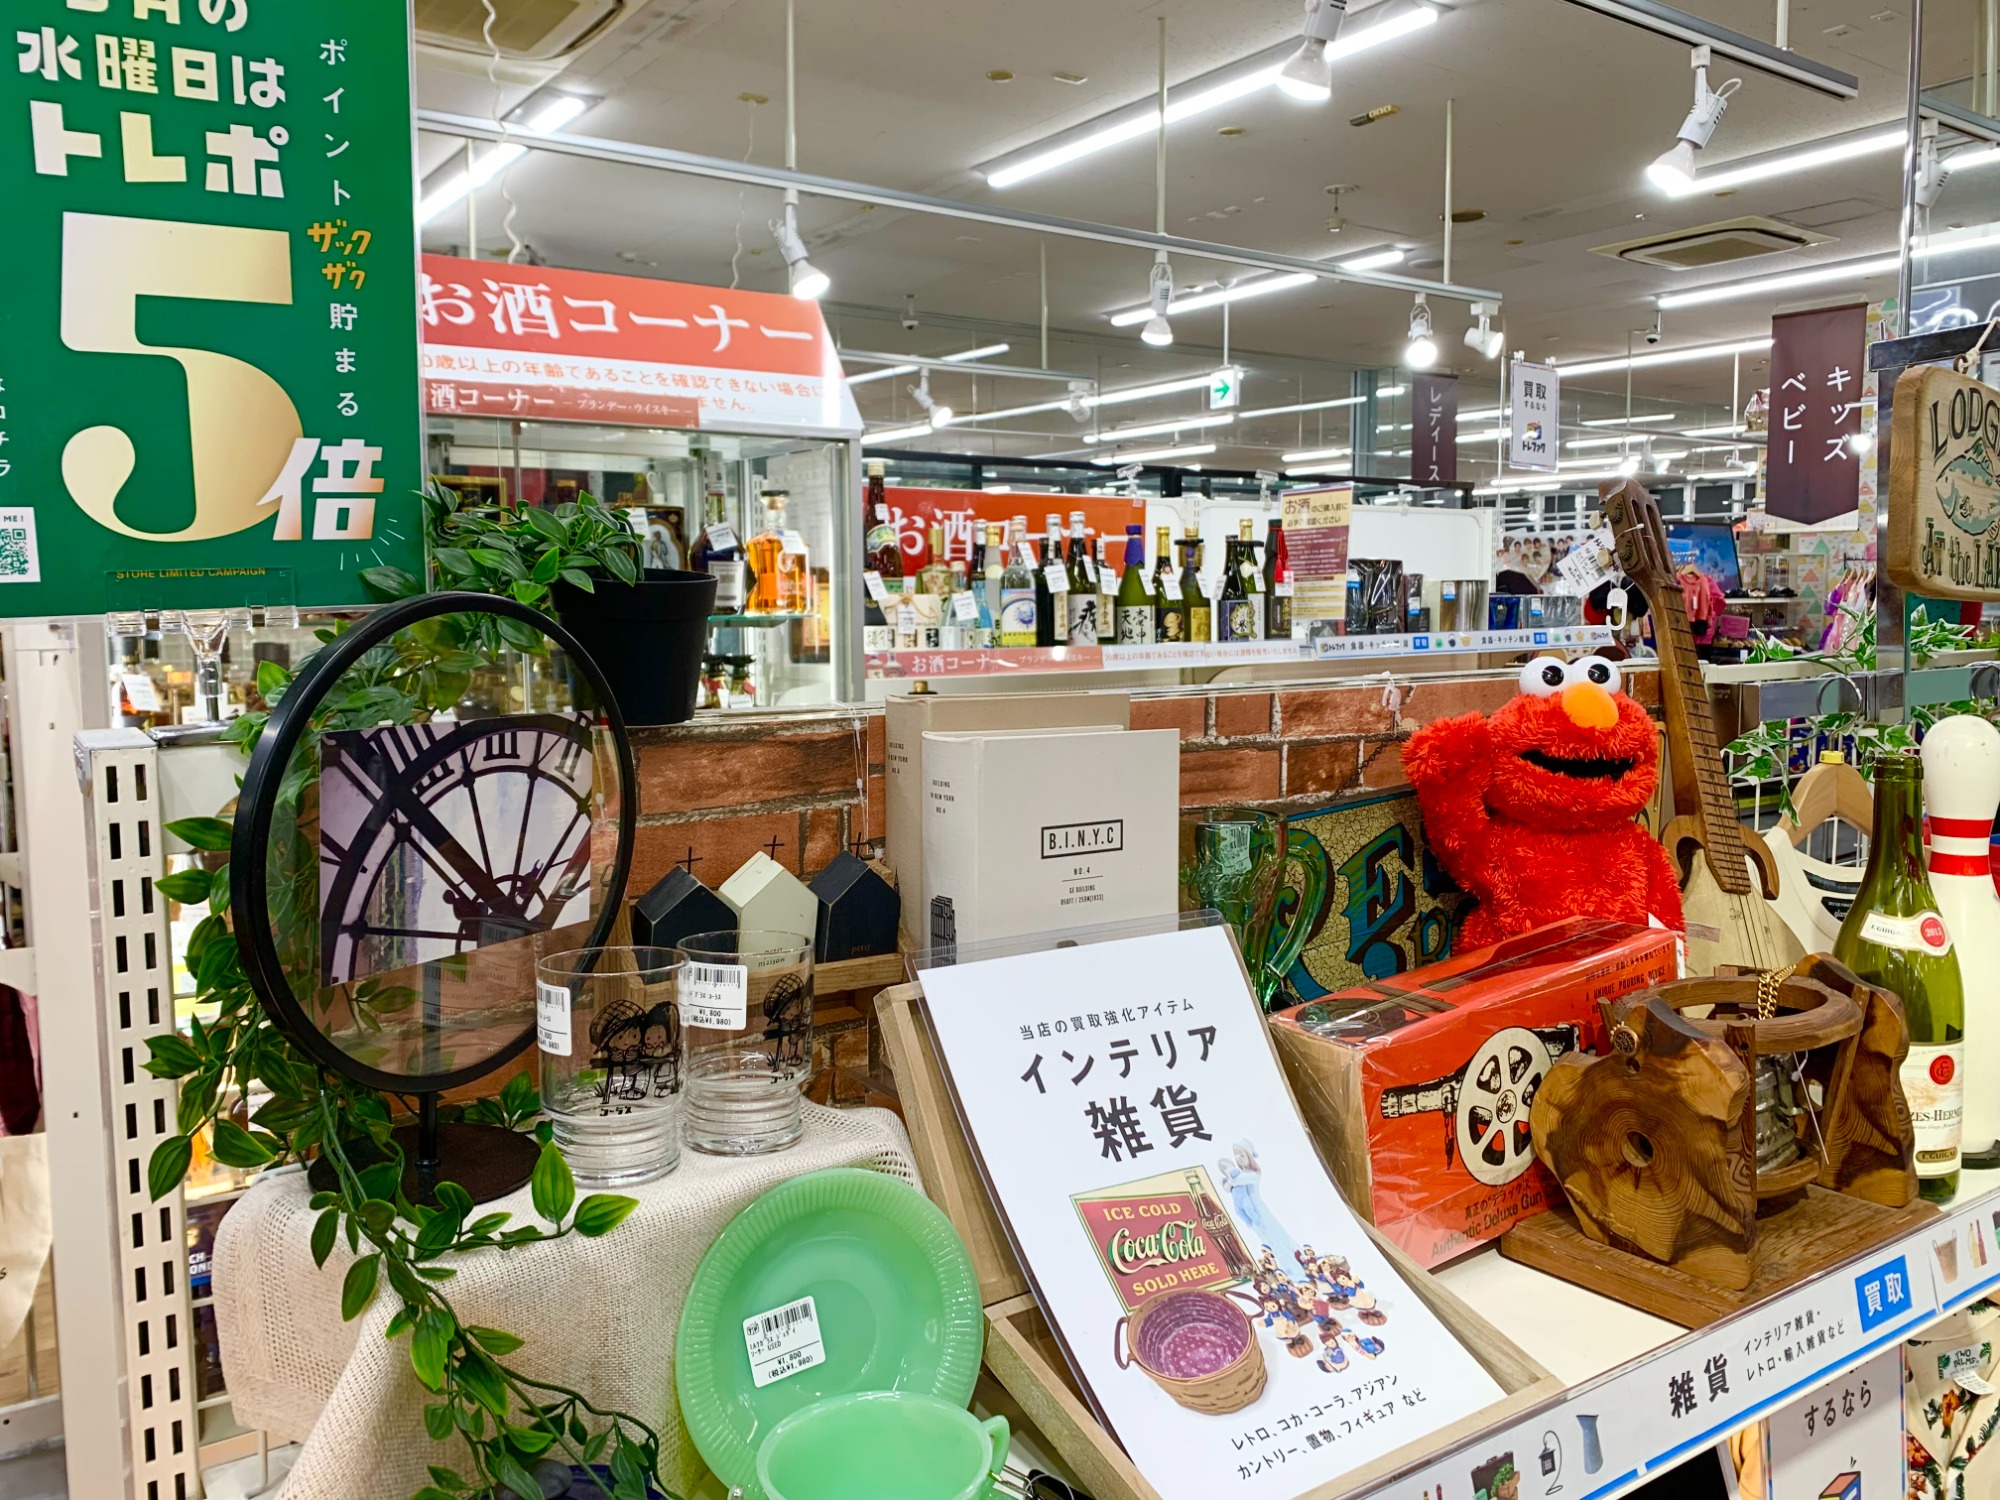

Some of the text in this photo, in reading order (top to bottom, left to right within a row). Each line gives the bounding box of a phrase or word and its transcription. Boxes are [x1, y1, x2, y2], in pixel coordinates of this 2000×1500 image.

[16, 26, 286, 108] 水曜日は
[29, 100, 290, 199] トレポ
[306, 38, 372, 418] ポイント ザック ザク 貯まる
[421, 273, 814, 353] お酒コーナー
[1523, 380, 1547, 400] 買取
[1524, 400, 1547, 411] するなら
[1781, 372, 1807, 464] ベビー
[1823, 366, 1852, 462] キッズ
[1428, 386, 1442, 481] レディース
[116, 566, 267, 580] STORE LIMITED CAMPAIGN
[1048, 826, 1115, 851] B.I.N.Y.C
[1593, 982, 1615, 1000] UNIQUE
[1618, 972, 1645, 991] POURING
[1019, 998, 1195, 1041] 当店の買取強化アイテム
[1020, 1025, 1217, 1095] インテリア
[1083, 1083, 1213, 1163] 雑貨
[1103, 1202, 1182, 1222] ICE COLD
[1431, 1222, 1482, 1258] Authentic
[1484, 1203, 1519, 1230] Deluxe
[1521, 1191, 1543, 1211] Gun
[1132, 1262, 1220, 1297] SOLD HERE
[1863, 1272, 1905, 1317] 買取
[777, 1350, 802, 1366] ¥1,800
[1746, 1318, 1845, 1383] レトロ・輸入雑貨など
[1955, 1348, 1972, 1359] TWO
[1231, 1374, 1399, 1452] レトロ、コカ・コーラ、アジアン
[1668, 1352, 1730, 1419] 雑貨
[1804, 1379, 1872, 1437] するなら
[1237, 1387, 1427, 1481] カントリー、置物、フィギュア など
